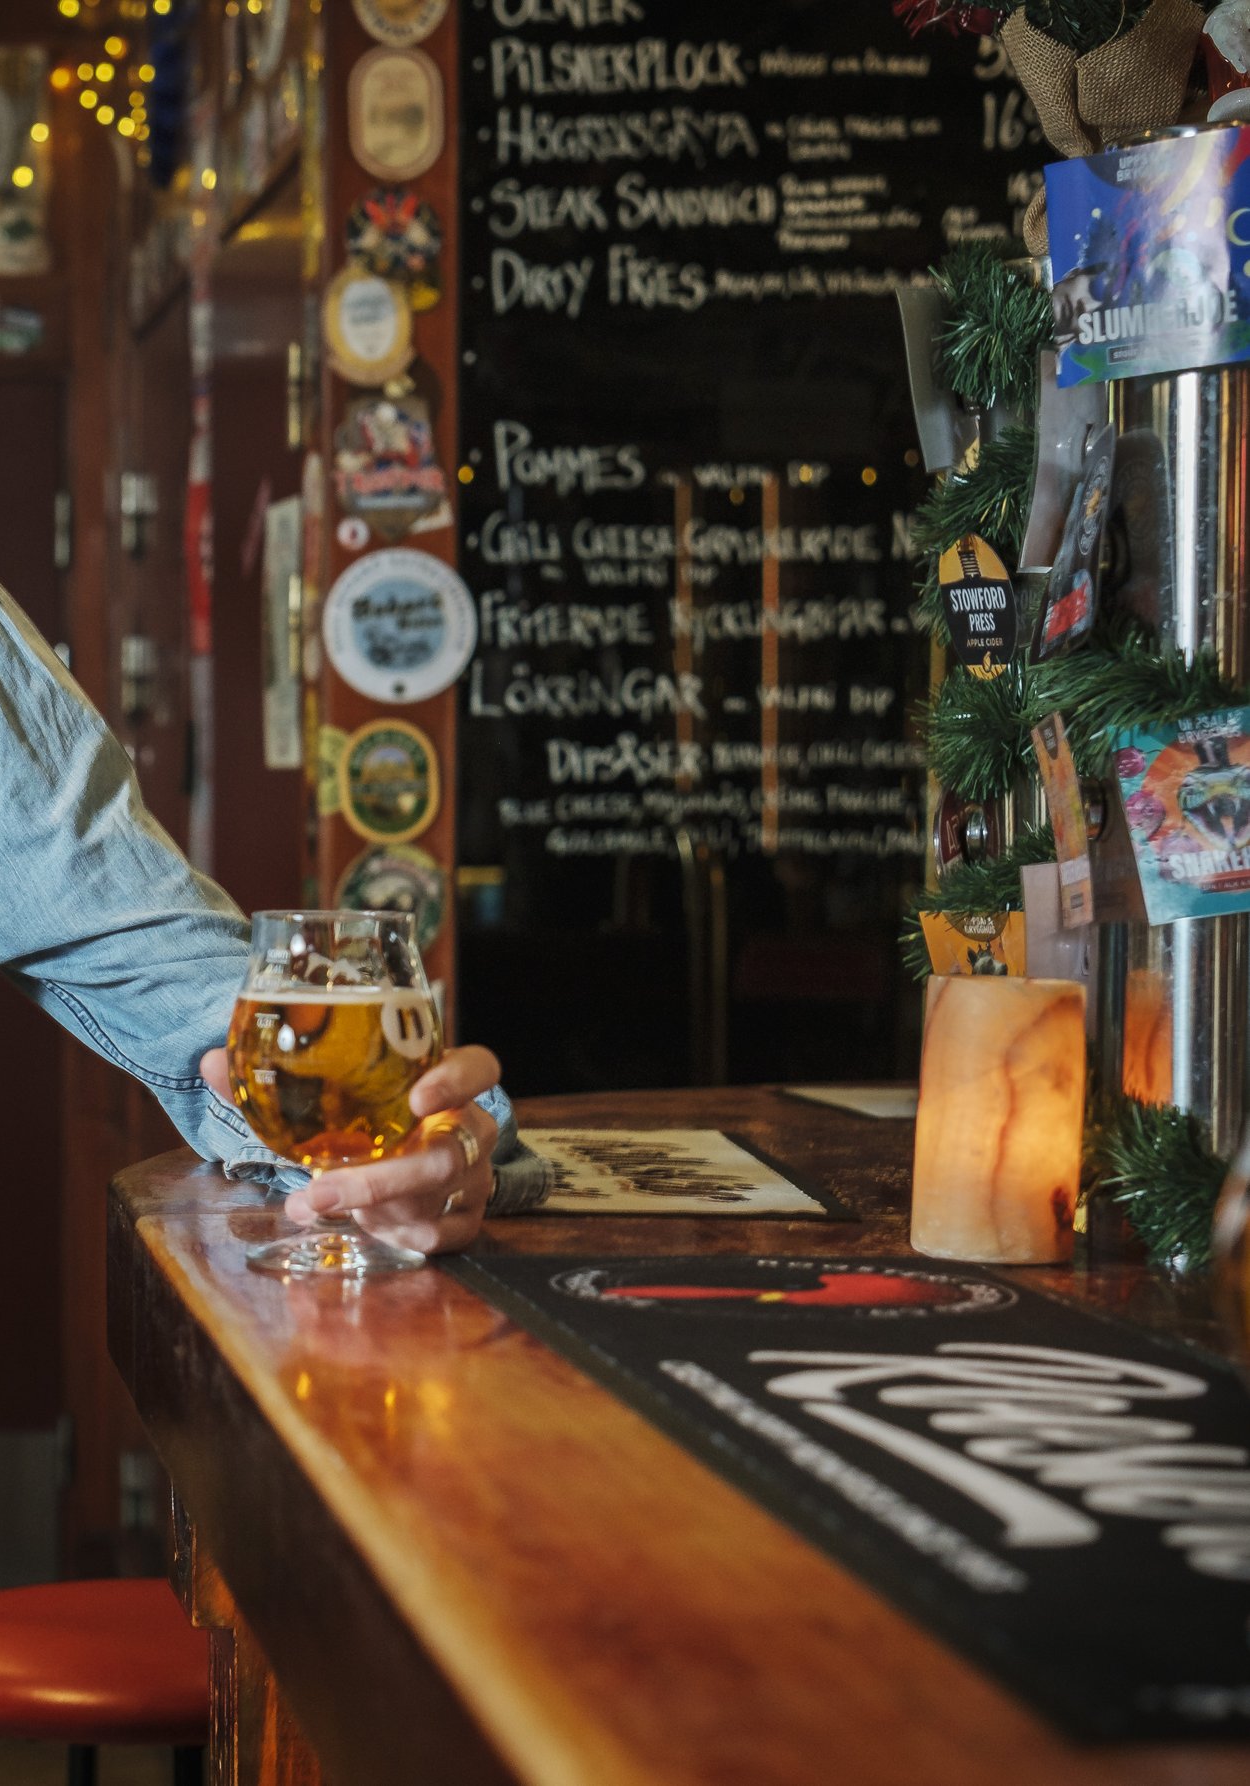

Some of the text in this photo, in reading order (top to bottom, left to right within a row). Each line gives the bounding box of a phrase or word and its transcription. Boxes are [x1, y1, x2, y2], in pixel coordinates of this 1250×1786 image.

[489, 179, 608, 238] STEAK
[491, 246, 593, 318] DIRTY
[608, 244, 708, 308] FRIES
[494, 419, 646, 496] POMMES
[949, 586, 1007, 613] STOWFORD
[966, 637, 1003, 648] APPLE CIDER
[968, 612, 997, 632] PRESS
